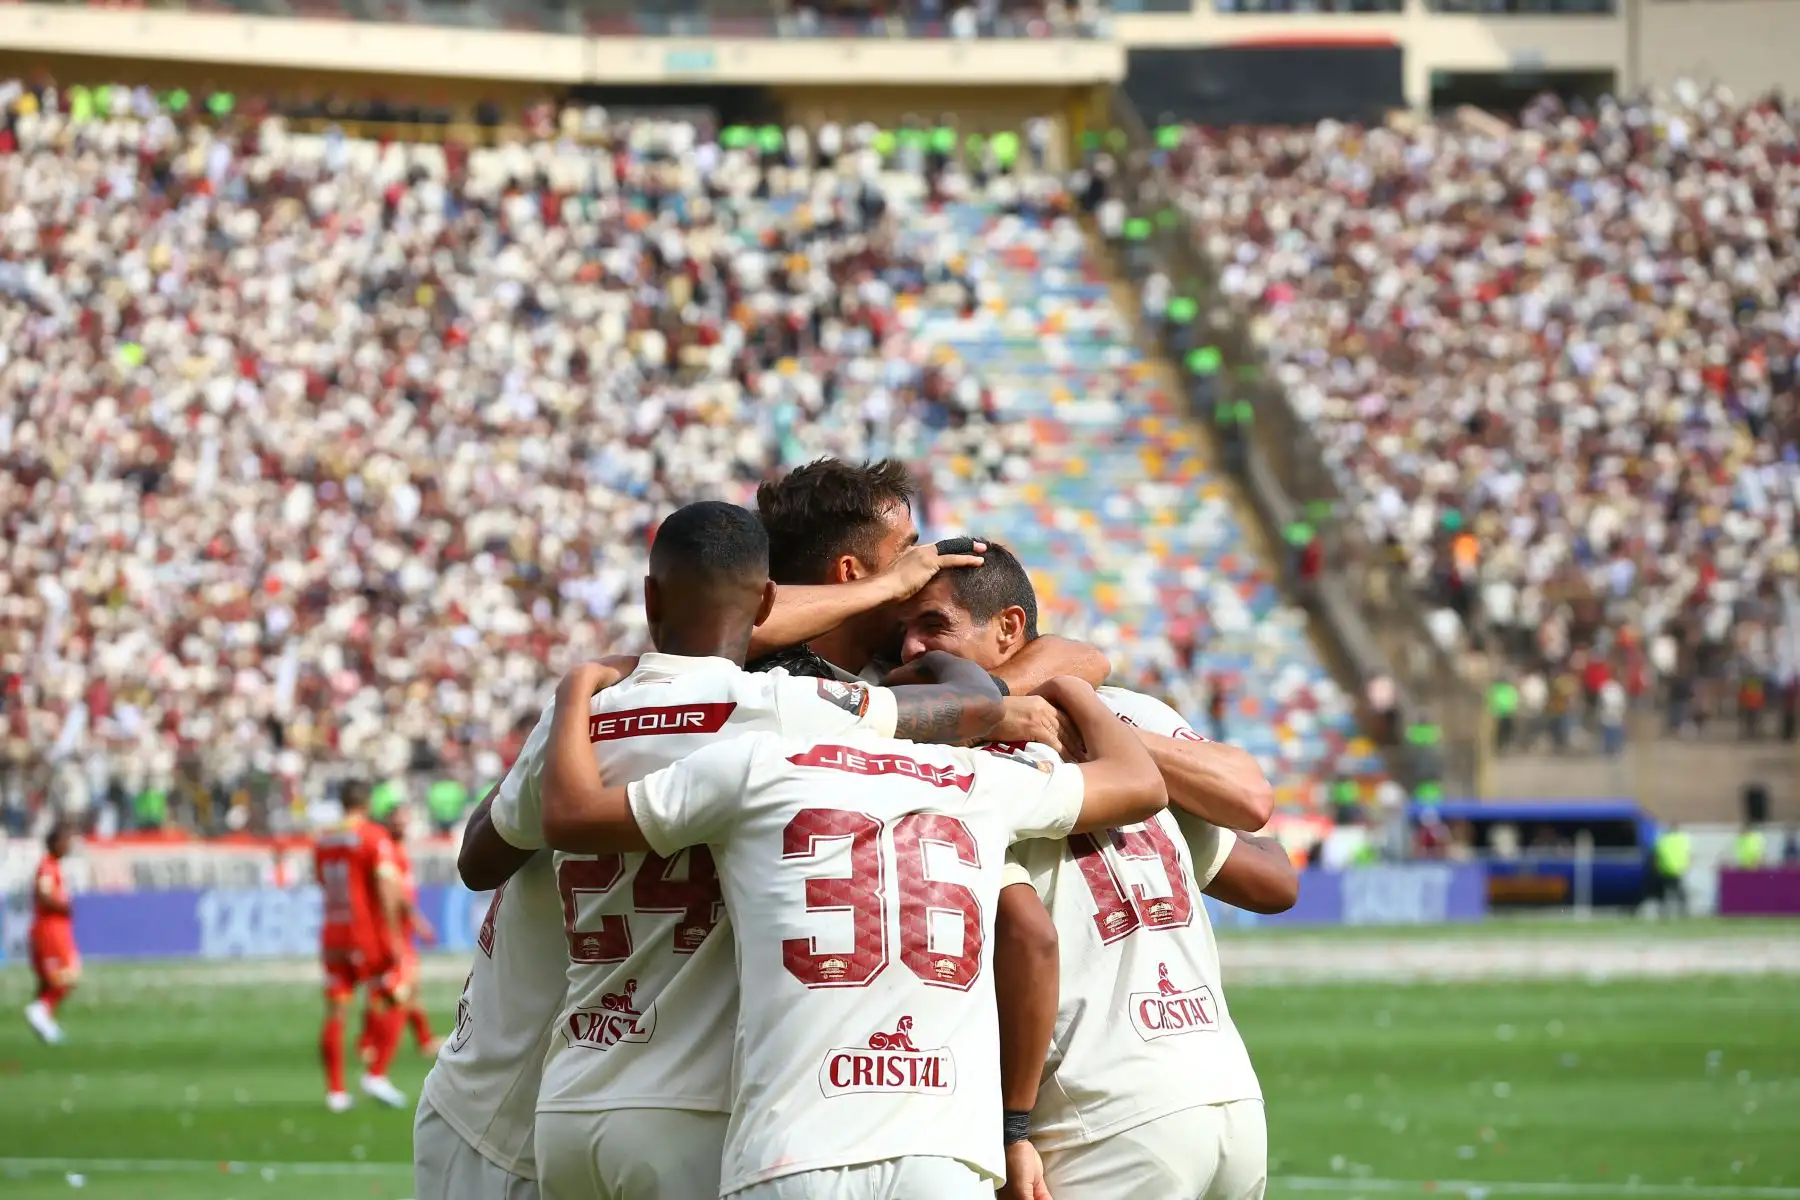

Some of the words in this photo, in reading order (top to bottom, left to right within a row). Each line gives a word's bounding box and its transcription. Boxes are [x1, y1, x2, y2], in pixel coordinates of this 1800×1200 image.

[820, 751, 959, 785] JETOUR
[557, 843, 725, 963] 24
[781, 808, 986, 992] 36
[1066, 815, 1194, 947] 19
[829, 1054, 948, 1088] CRISTAL
